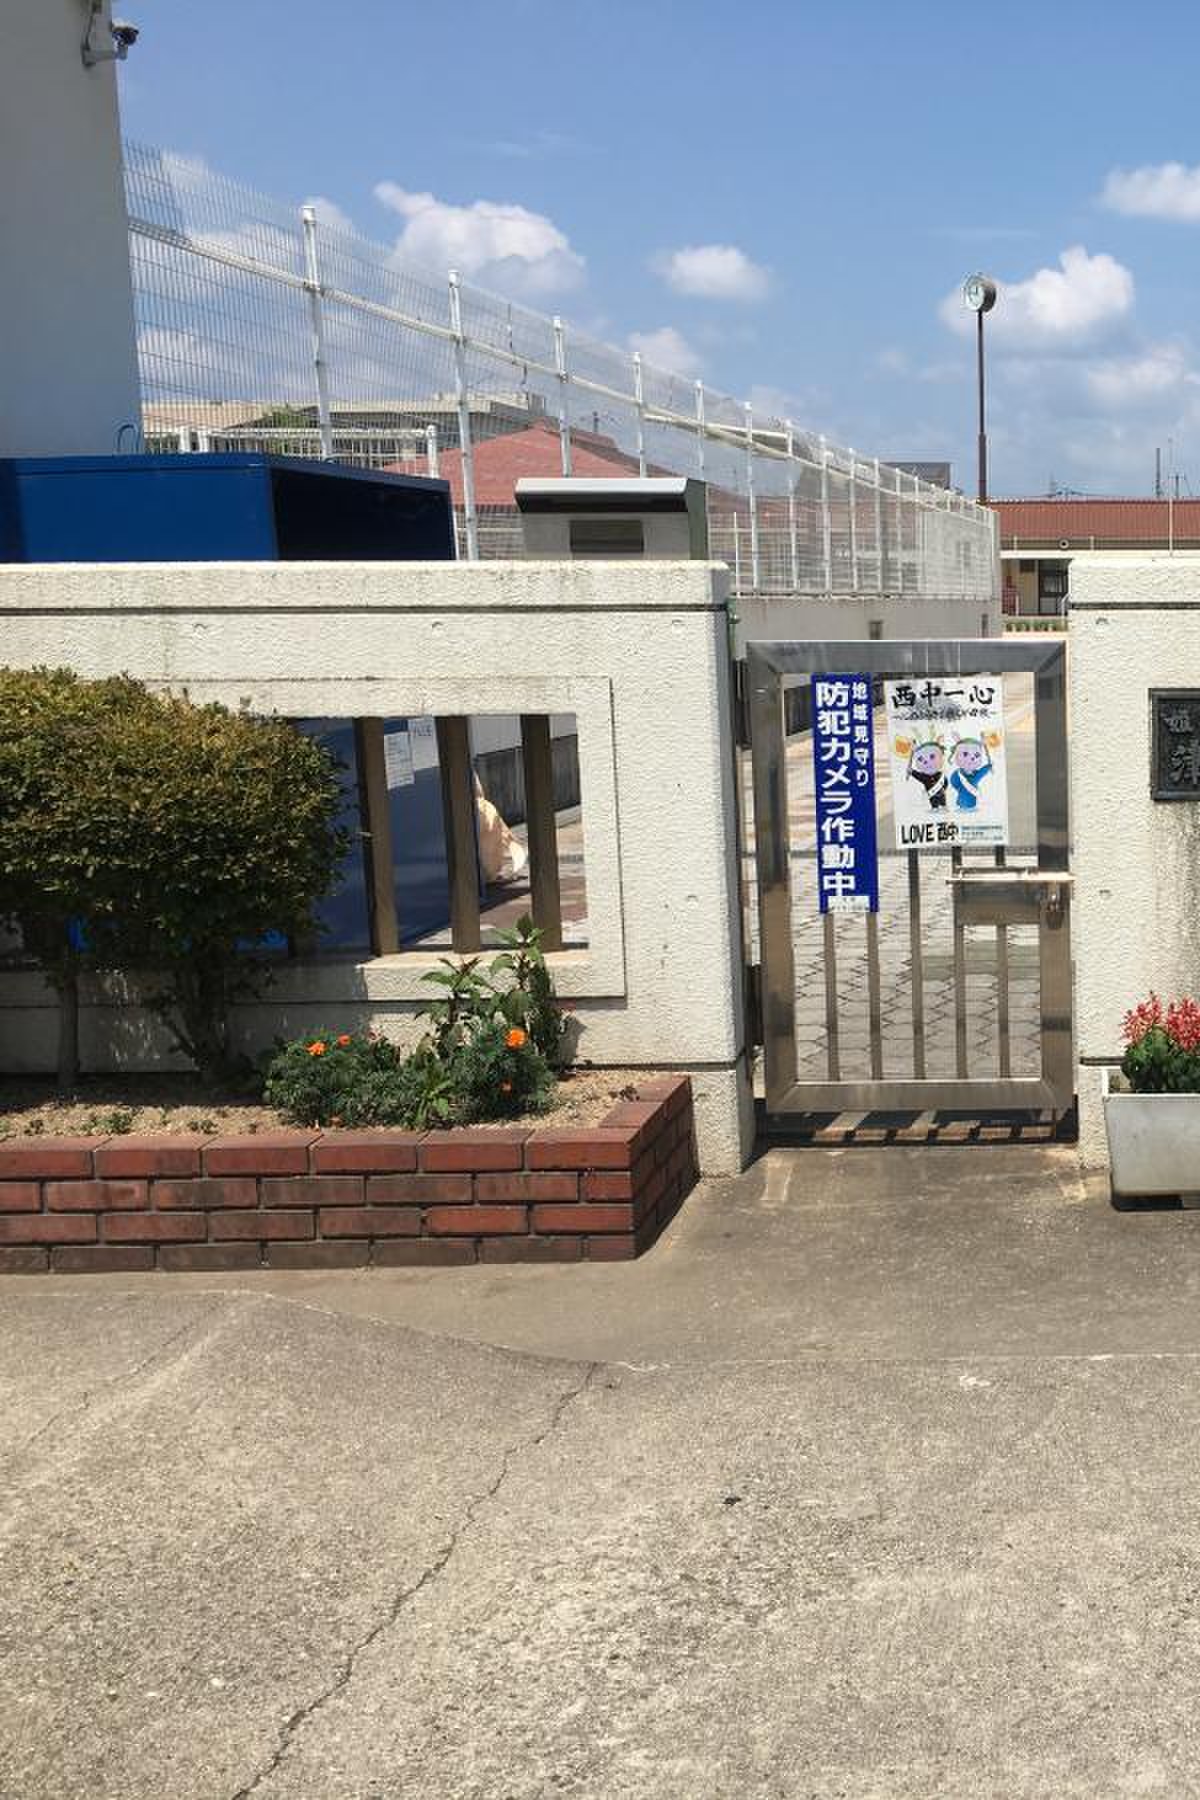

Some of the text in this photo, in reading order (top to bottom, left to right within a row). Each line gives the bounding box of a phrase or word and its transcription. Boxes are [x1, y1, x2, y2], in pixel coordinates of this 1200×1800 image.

[892, 681, 995, 708] 西中一心
[851, 682, 870, 787] 地域見守り
[815, 682, 857, 897] 防犯カメラ作動中
[900, 822, 933, 844] LOVE
